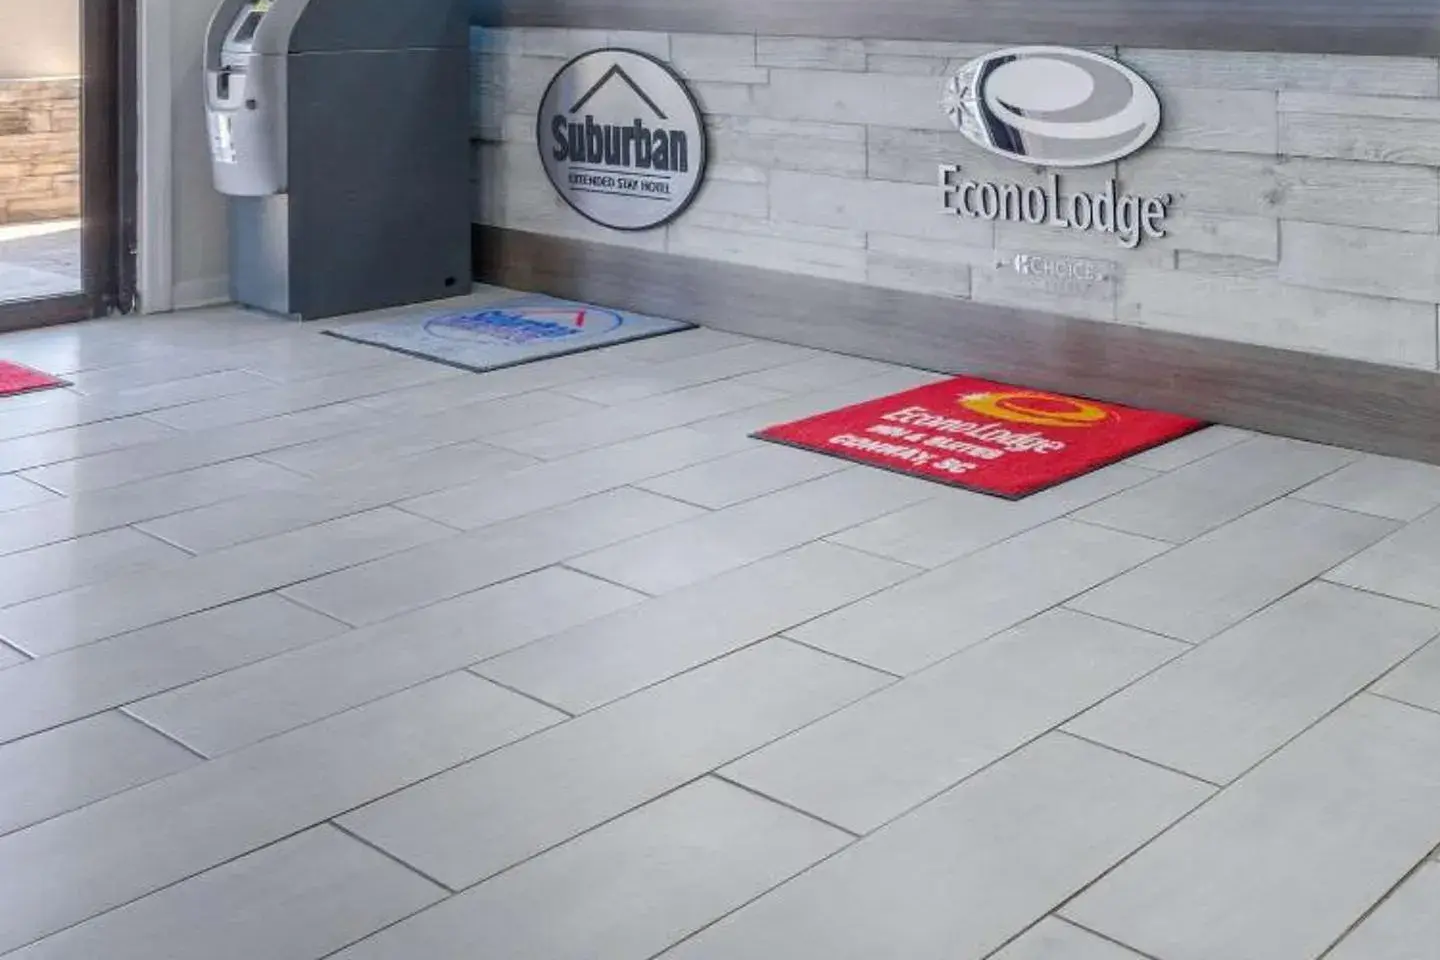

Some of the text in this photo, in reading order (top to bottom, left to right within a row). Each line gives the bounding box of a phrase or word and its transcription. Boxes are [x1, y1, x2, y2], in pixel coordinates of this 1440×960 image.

[553, 115, 688, 172] Suburban
[568, 172, 671, 194] EXTENDED STAY HOTEL
[938, 164, 1170, 248] EconoLodge
[1030, 256, 1095, 281] CHOICE
